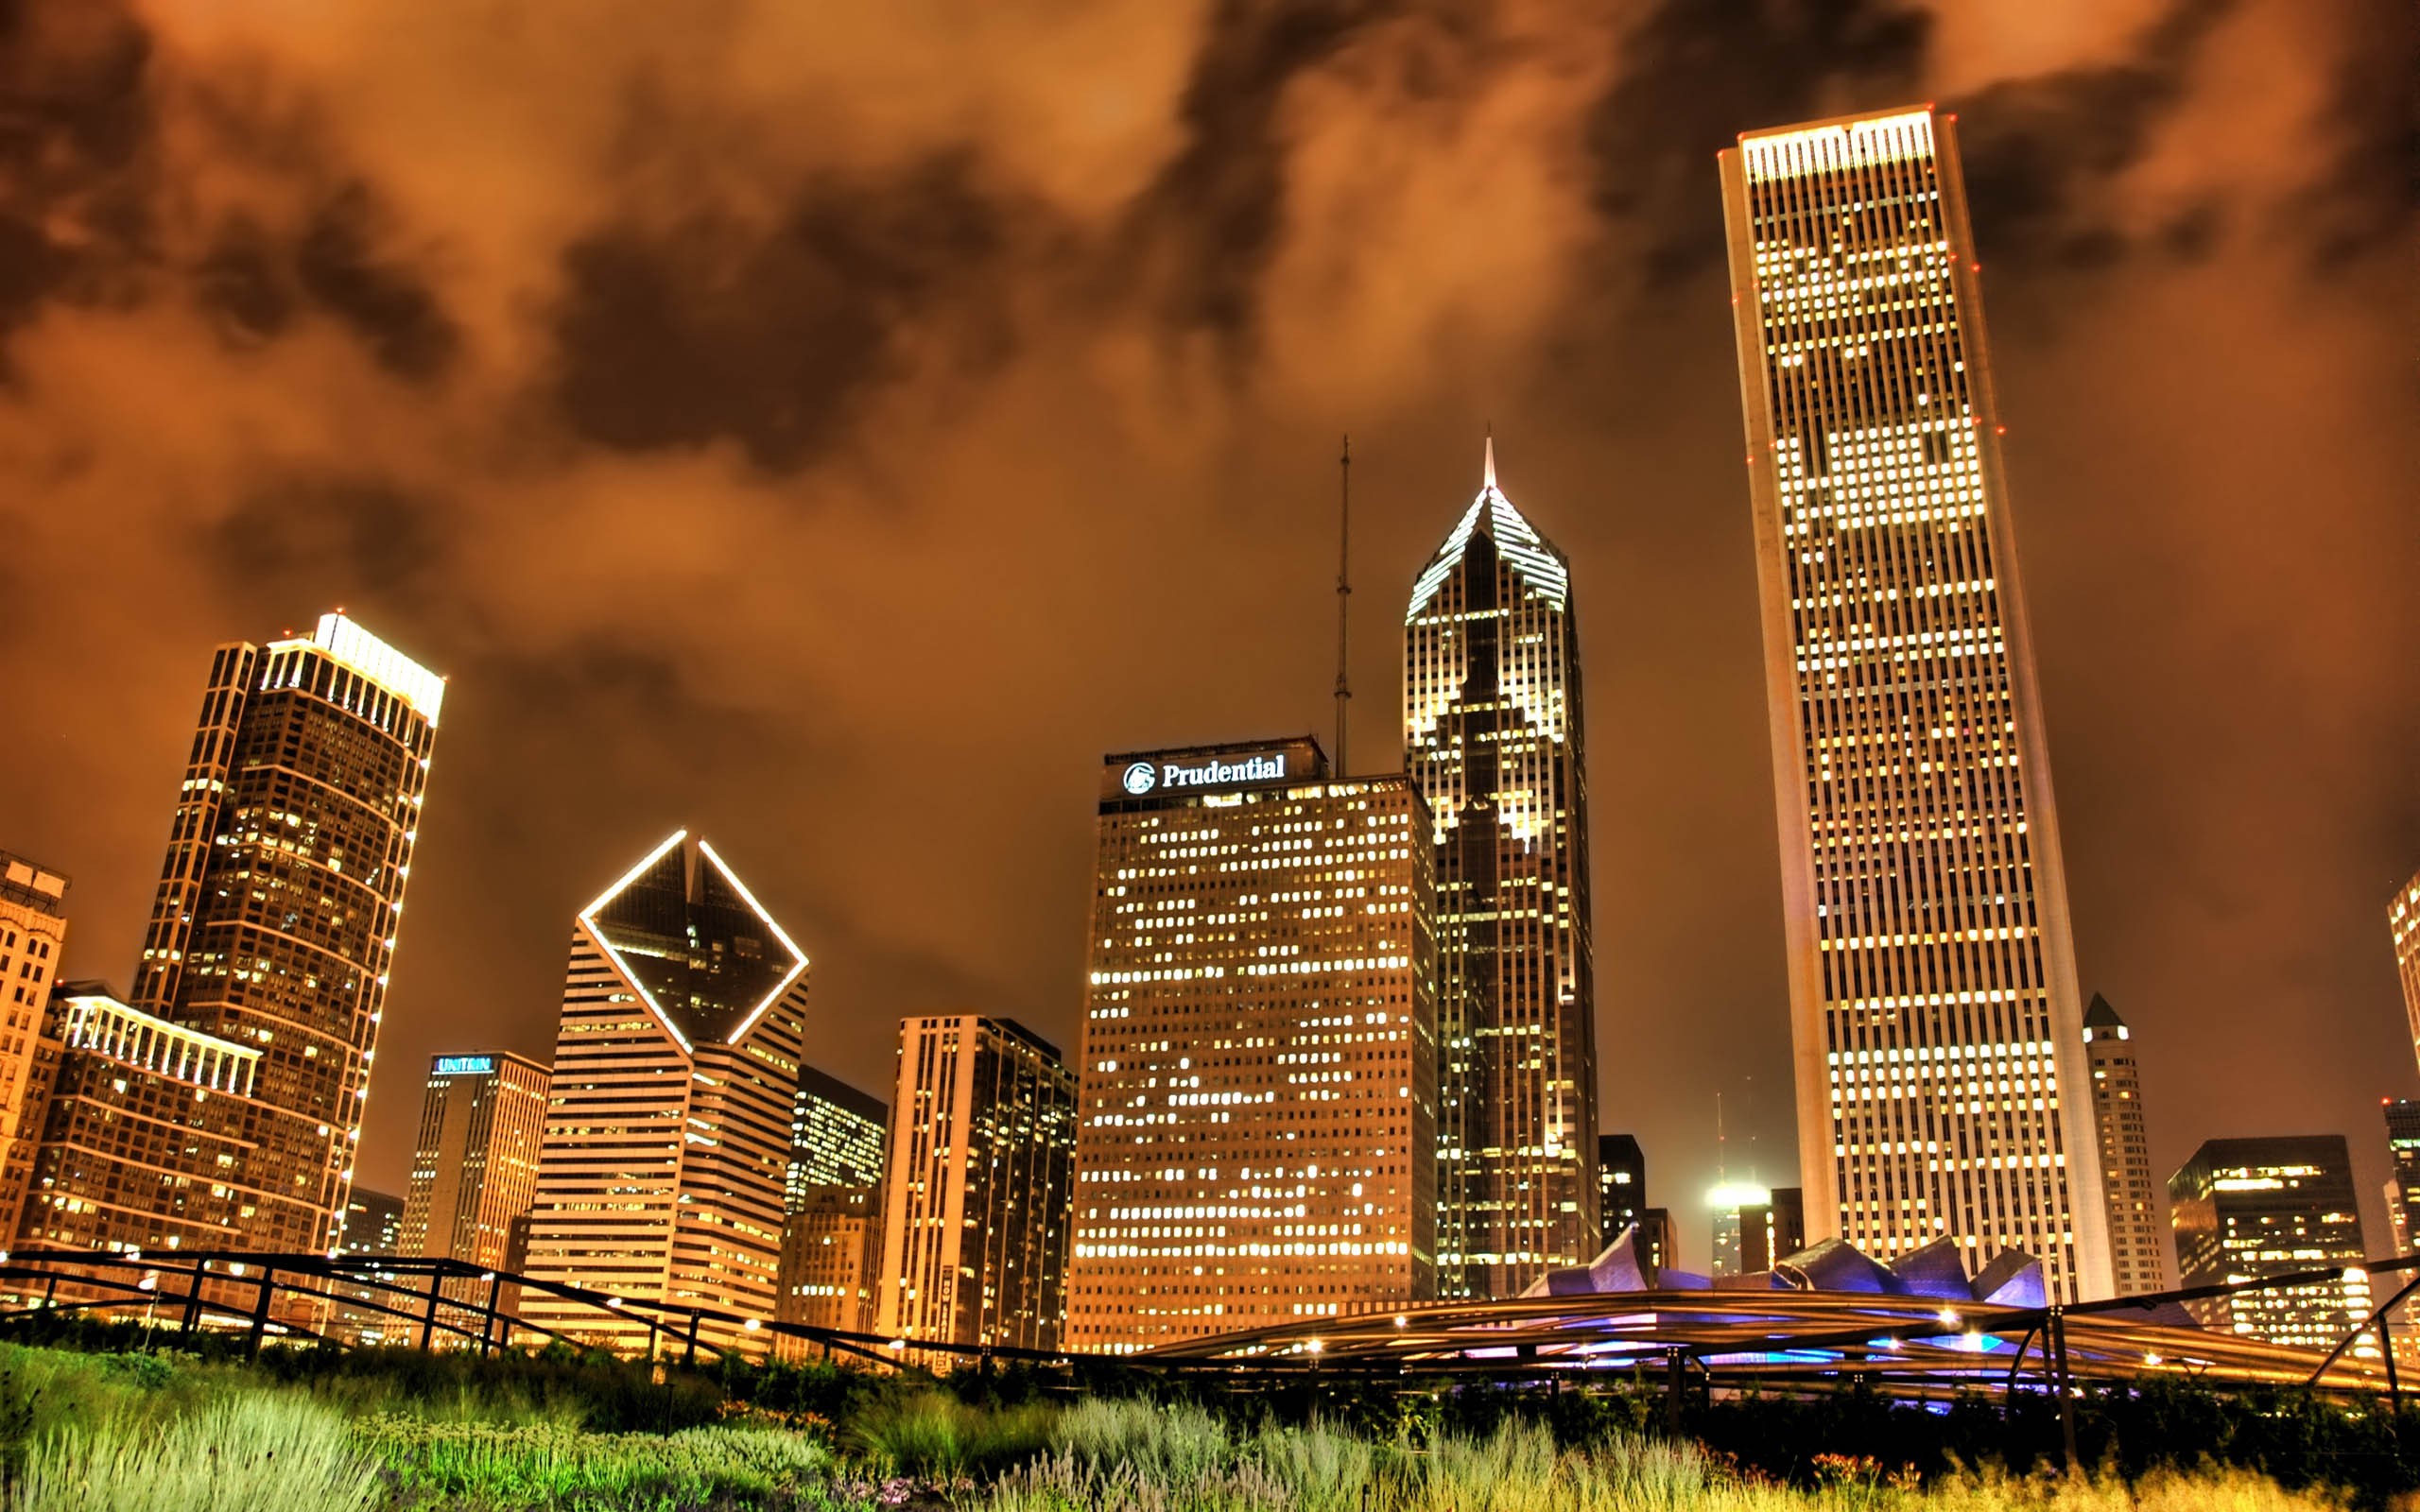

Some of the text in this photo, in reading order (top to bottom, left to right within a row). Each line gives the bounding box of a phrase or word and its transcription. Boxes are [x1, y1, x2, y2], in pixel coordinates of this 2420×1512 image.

[1162, 755, 1285, 787] Prudential
[438, 1057, 491, 1072] UNITRIN
[942, 1279, 951, 1302] NOW
